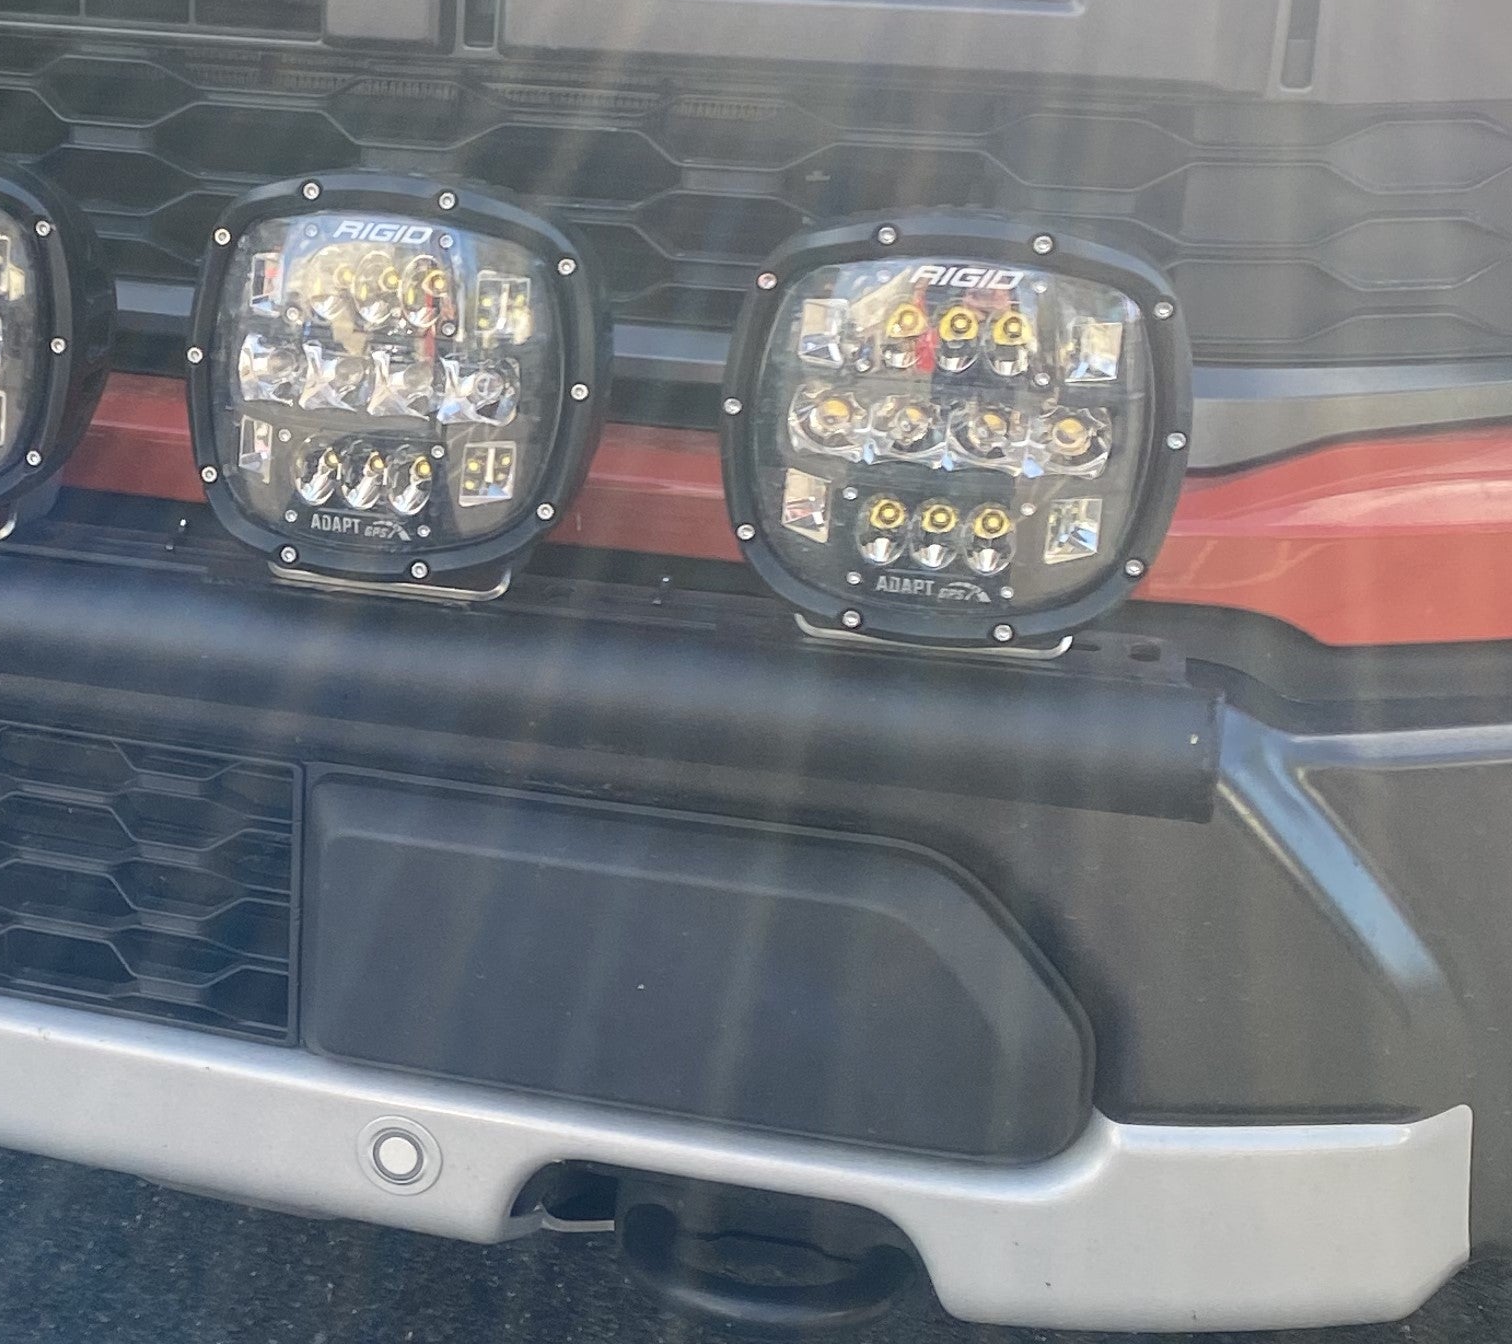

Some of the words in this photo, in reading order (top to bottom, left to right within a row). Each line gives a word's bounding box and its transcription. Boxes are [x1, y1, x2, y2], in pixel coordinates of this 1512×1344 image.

[332, 220, 433, 244] RIGID
[909, 265, 1024, 289] RIGID
[310, 513, 361, 534] ADAPT
[875, 576, 935, 596] ADAPT
